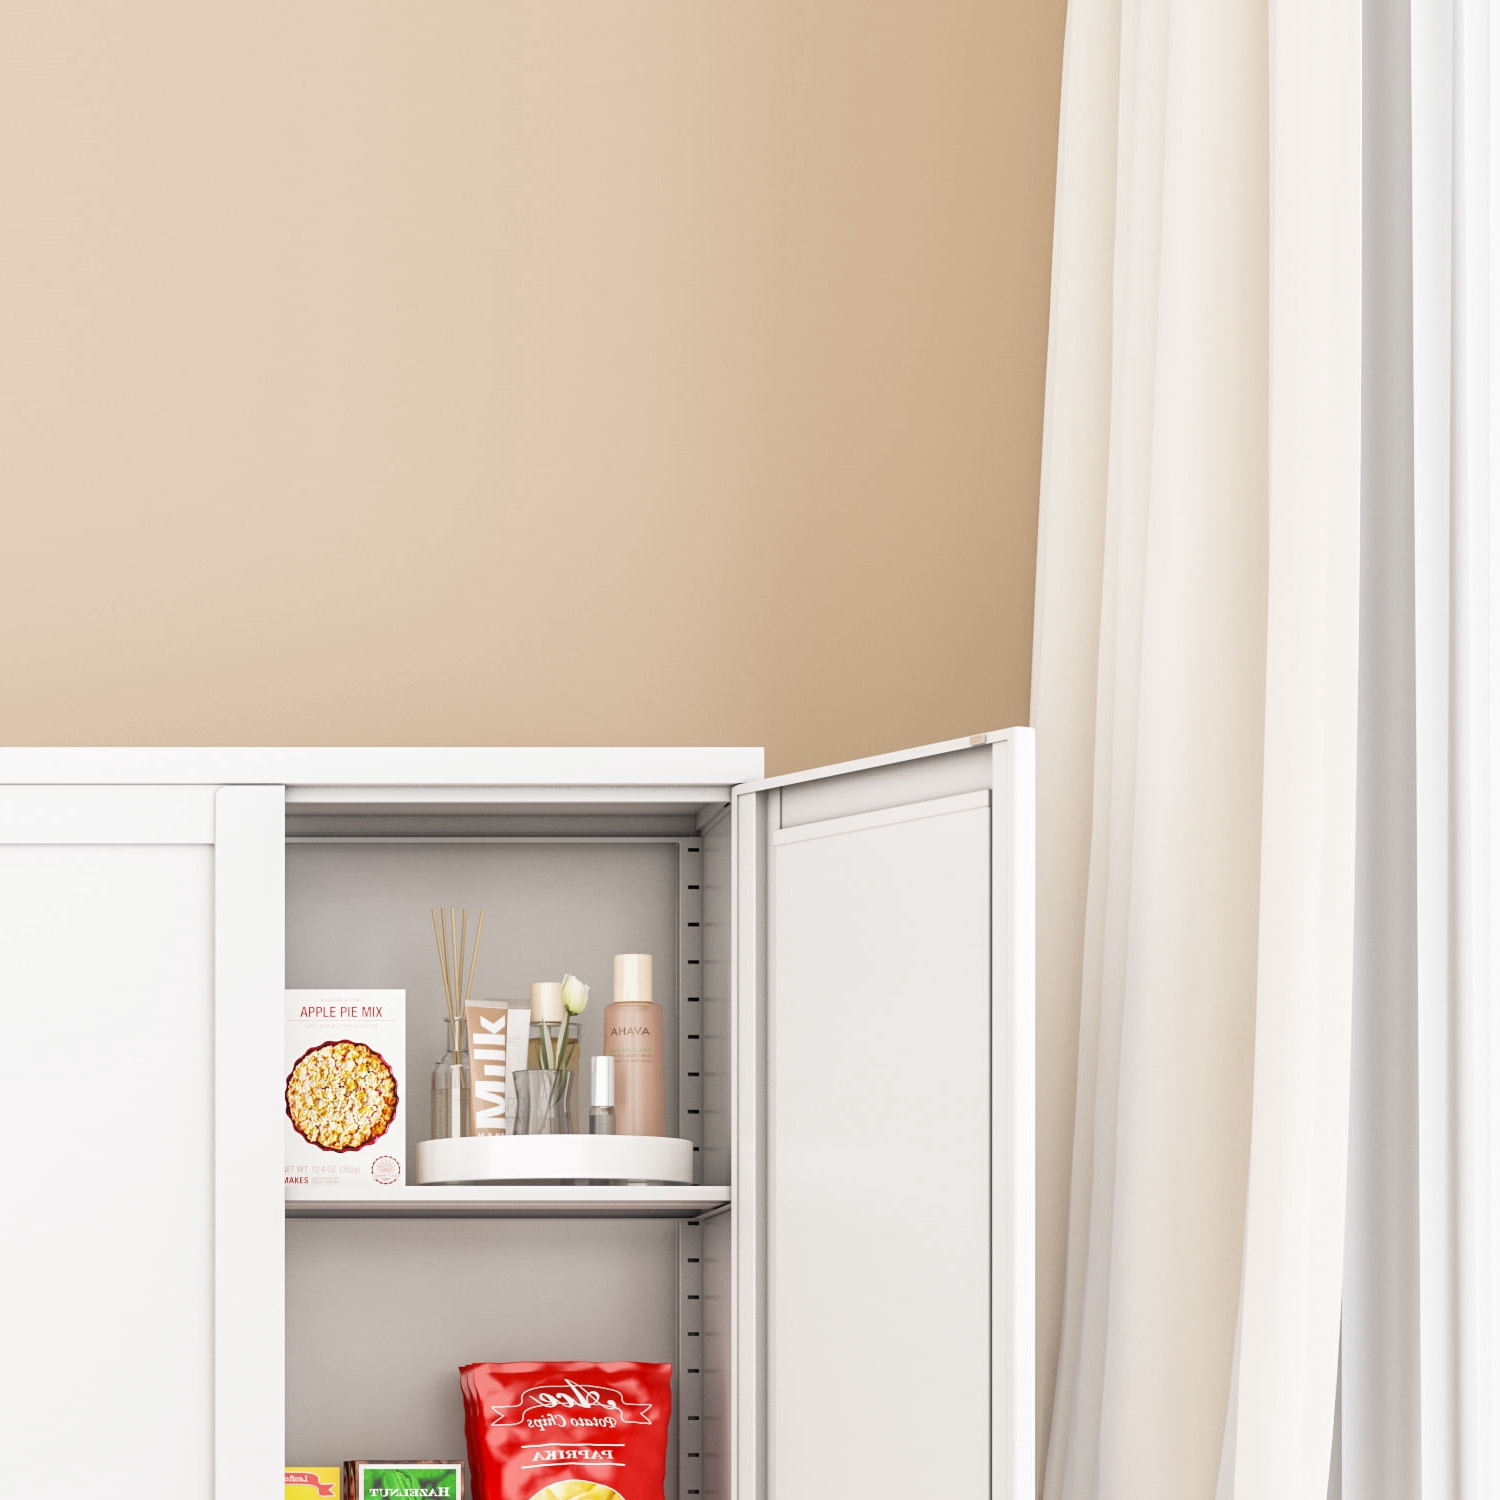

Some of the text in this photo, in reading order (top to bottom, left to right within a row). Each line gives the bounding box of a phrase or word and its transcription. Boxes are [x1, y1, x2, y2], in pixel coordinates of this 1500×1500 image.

[300, 1006, 383, 1018] APPLE PIE MIX
[610, 1027, 651, 1036] AHAVA
[472, 1015, 506, 1129] Milk
